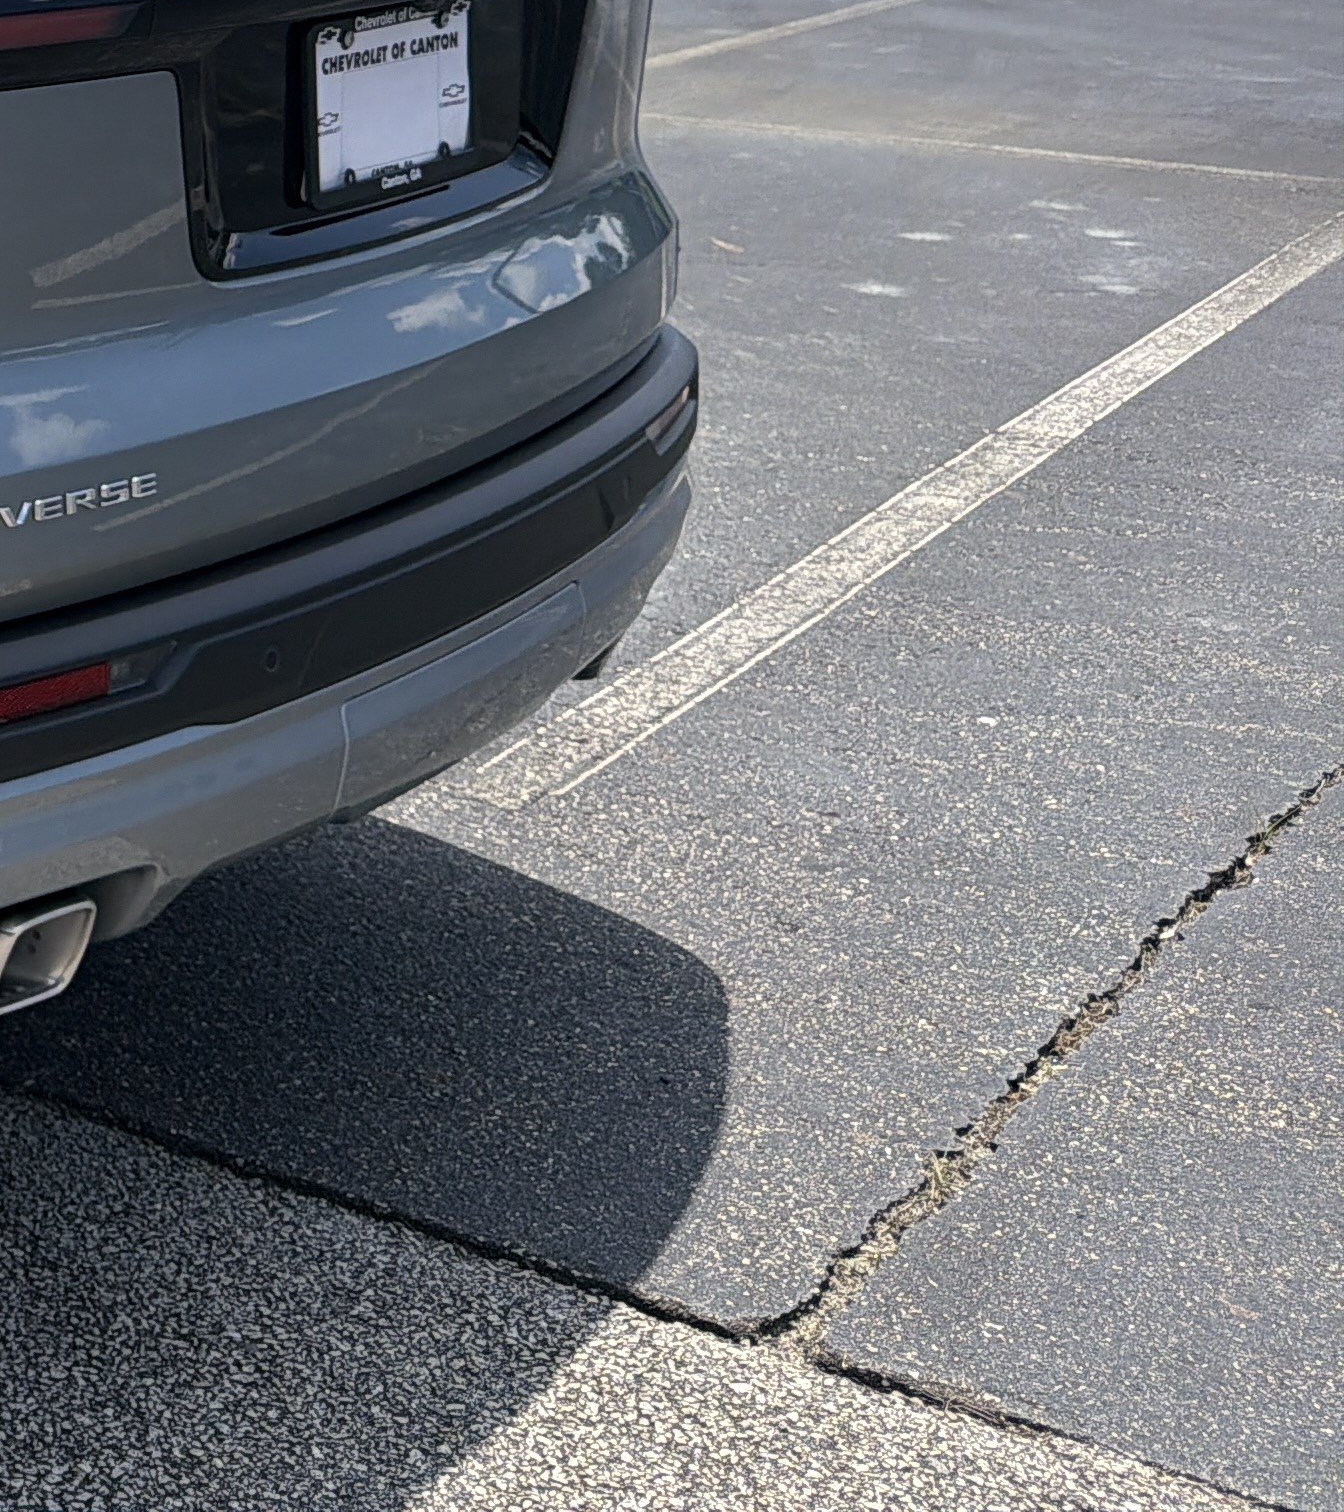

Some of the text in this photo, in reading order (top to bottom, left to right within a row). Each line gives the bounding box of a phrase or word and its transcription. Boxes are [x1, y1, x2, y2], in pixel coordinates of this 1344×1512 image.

[321, 31, 459, 75] CHEVROLET OF CANTON
